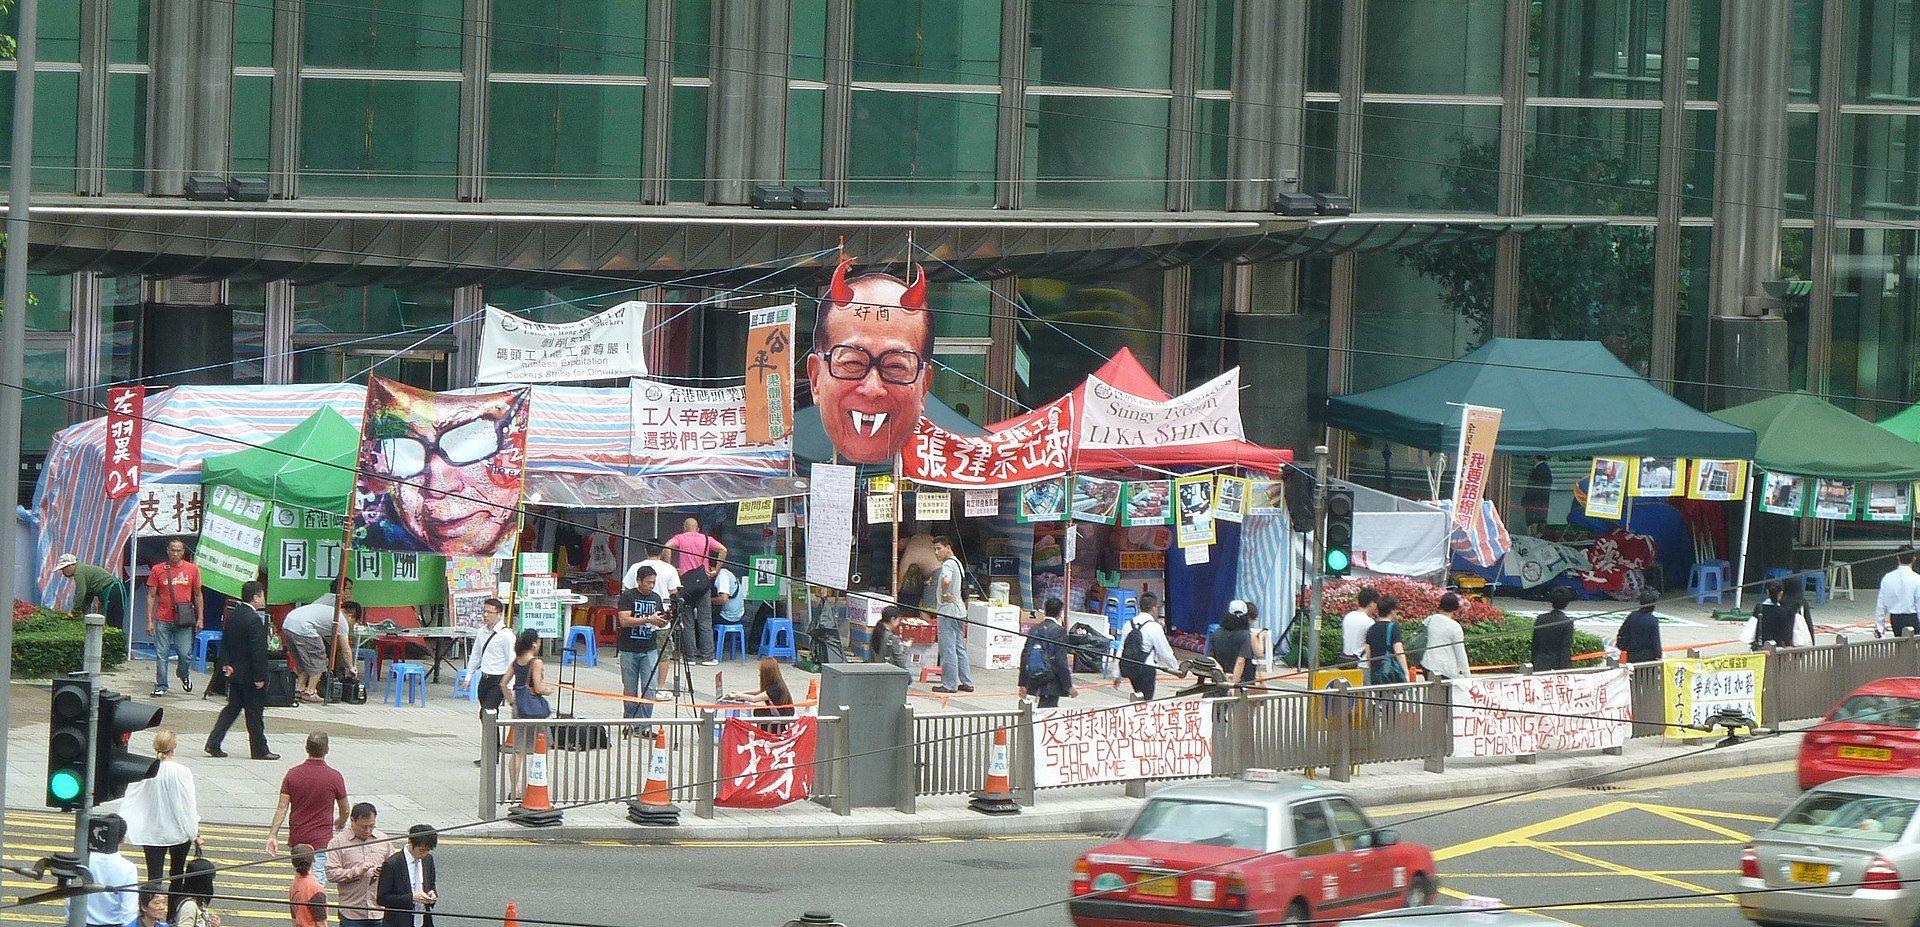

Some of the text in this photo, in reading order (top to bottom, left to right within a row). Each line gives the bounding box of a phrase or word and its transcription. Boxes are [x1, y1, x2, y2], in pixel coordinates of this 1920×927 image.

[1106, 402, 1158, 425] Stingy
[138, 491, 201, 534] 支持
[282, 540, 418, 579] 同工同酬
[1046, 743, 1090, 767] STOP
[1060, 763, 1100, 784] SHOW
[1140, 756, 1204, 776] DIGNITY
